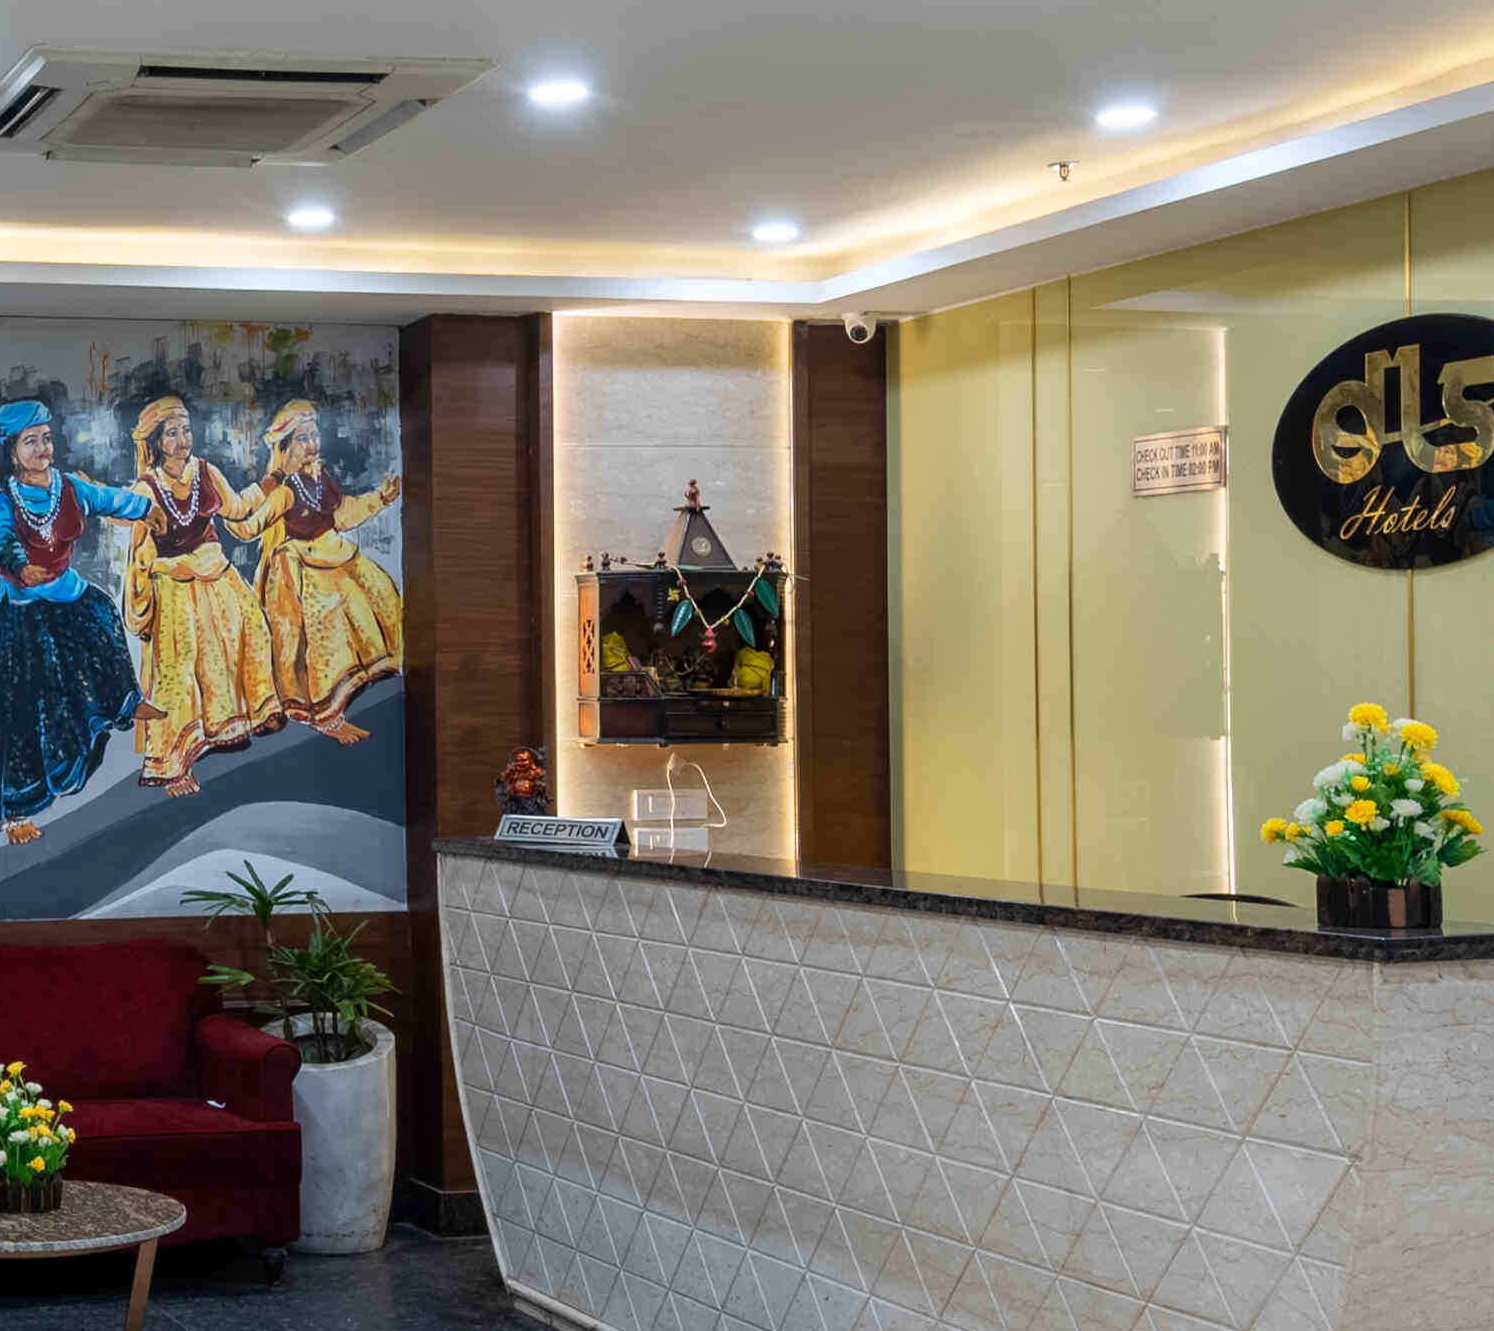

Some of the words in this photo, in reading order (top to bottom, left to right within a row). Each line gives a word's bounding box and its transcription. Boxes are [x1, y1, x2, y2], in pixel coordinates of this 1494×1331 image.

[1137, 447, 1160, 463] CHECK
[1174, 444, 1191, 459] TIME
[1136, 466, 1161, 482] CHECK
[1171, 462, 1187, 479] TIME
[1339, 486, 1457, 541] Hotels
[506, 821, 610, 839] RECEPTION
